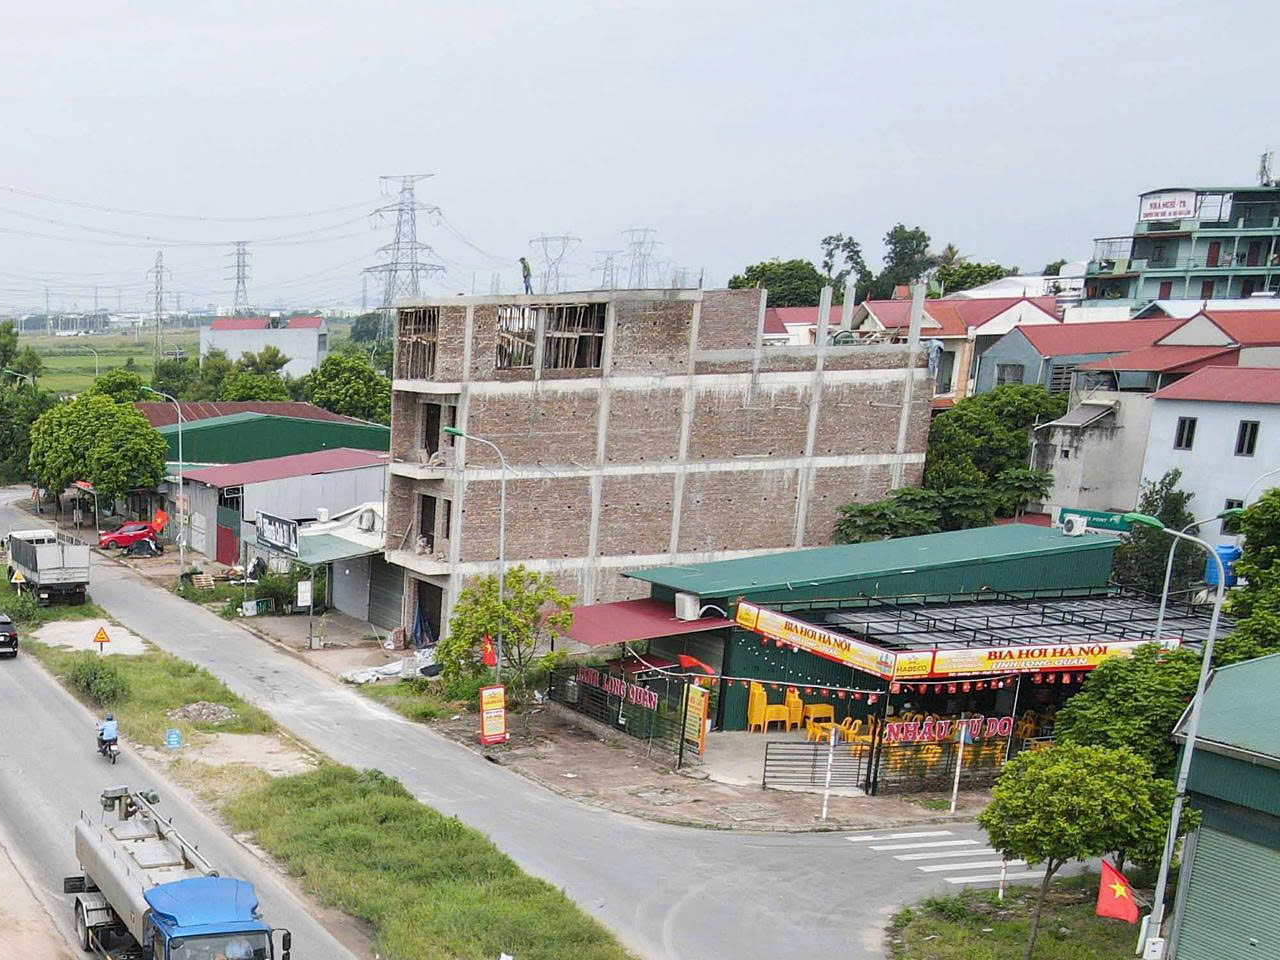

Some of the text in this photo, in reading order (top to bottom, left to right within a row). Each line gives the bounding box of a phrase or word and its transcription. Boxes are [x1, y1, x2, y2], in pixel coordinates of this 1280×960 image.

[784, 620, 799, 635] BIA
[800, 627, 817, 641] HƠI
[833, 637, 851, 652] NỘI
[987, 649, 1015, 660] BIA
[1017, 647, 1049, 659] HƠI
[1051, 643, 1075, 658] HÀ
[1078, 643, 1109, 658] NỘI
[896, 665, 928, 673] HADECO
[602, 672, 627, 698] LONG
[985, 716, 1013, 737] DO
